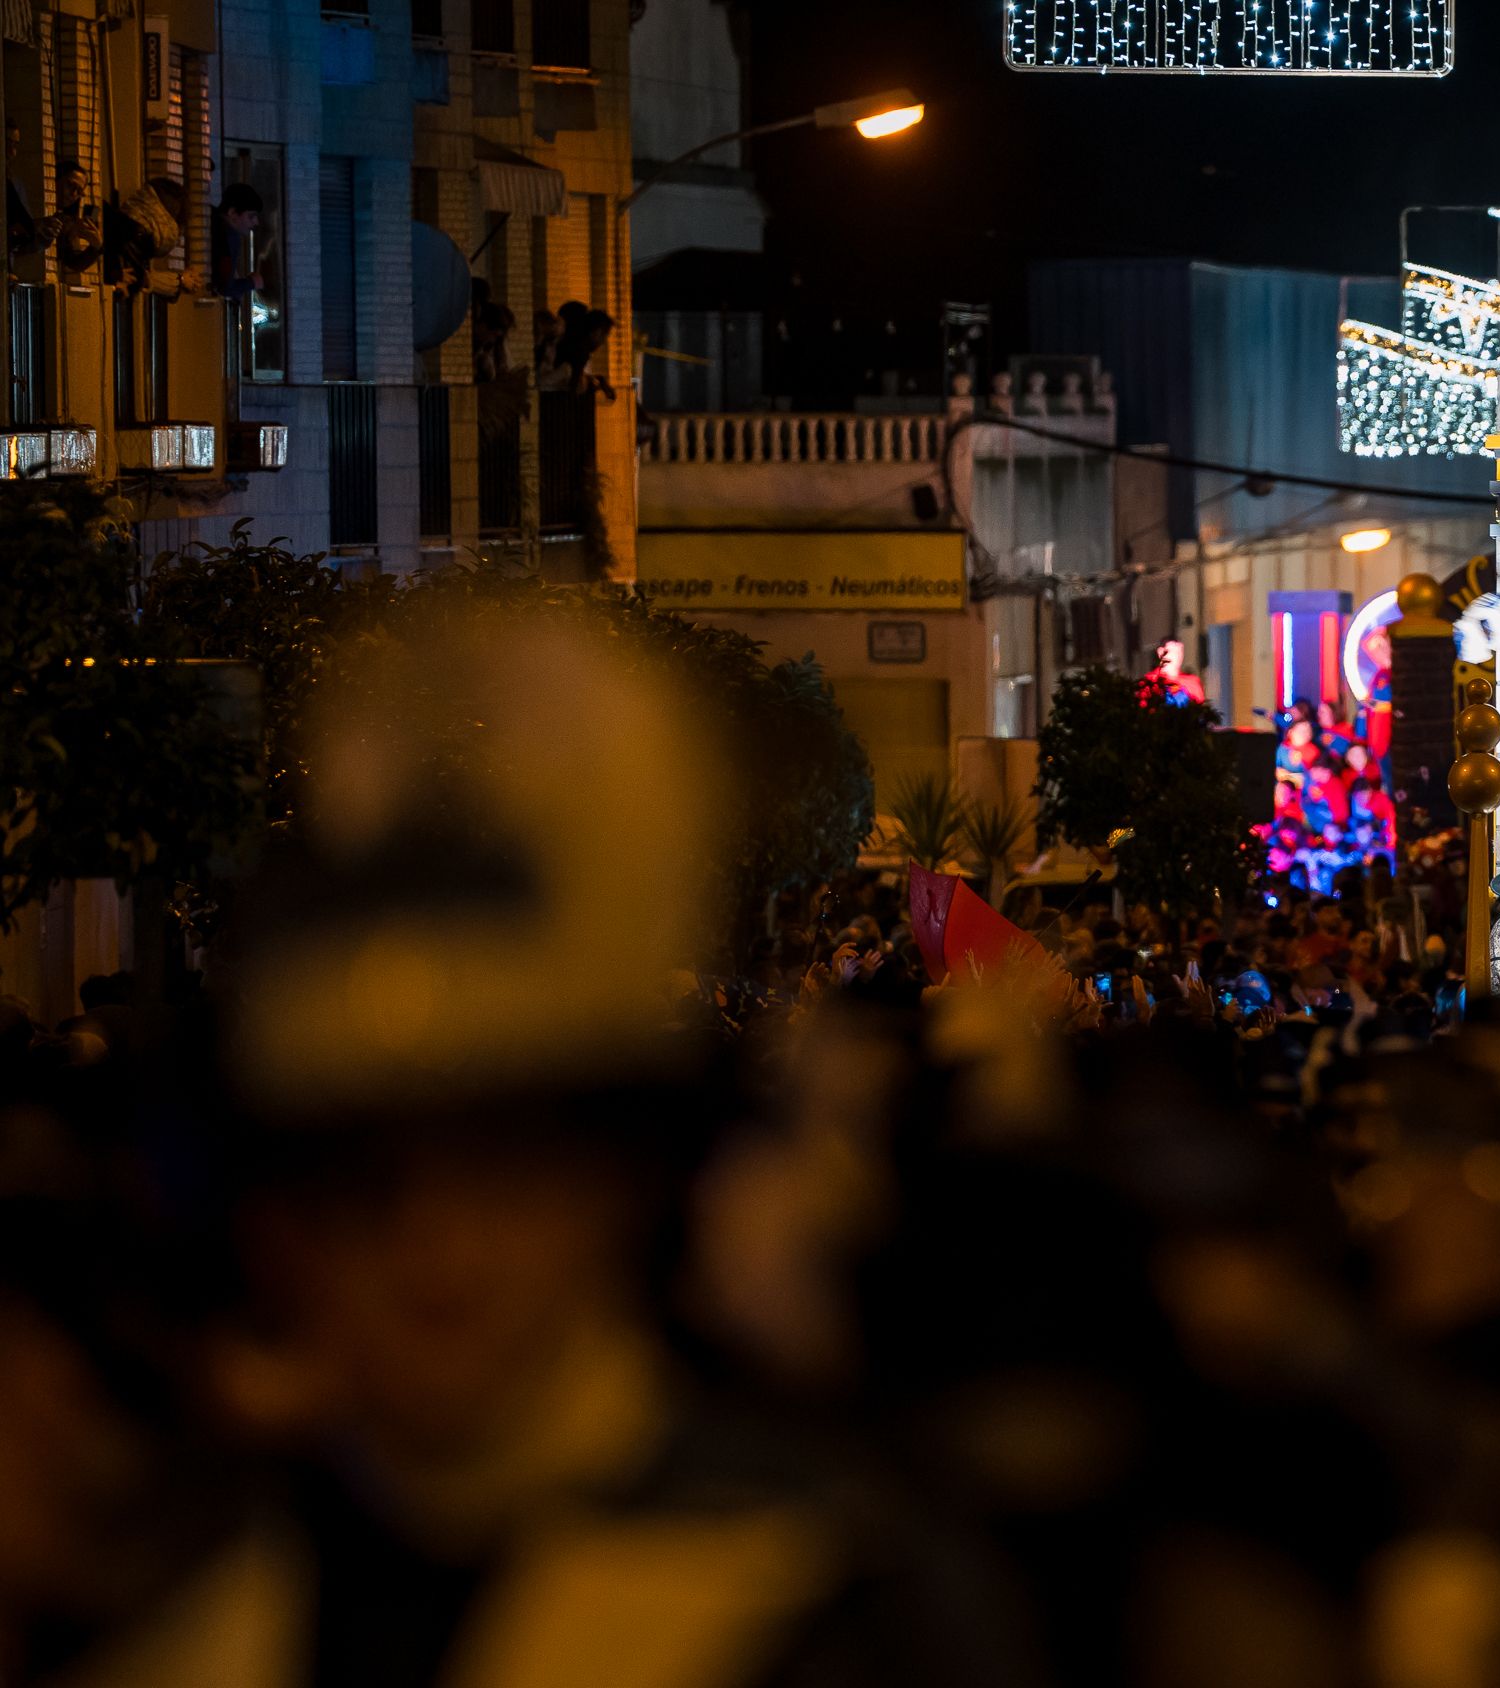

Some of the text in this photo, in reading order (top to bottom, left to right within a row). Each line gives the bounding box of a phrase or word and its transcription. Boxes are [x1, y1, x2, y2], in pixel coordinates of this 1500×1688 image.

[147, 36, 158, 98] DAEWOO
[735, 574, 809, 596] Frenos
[831, 574, 961, 596] Neumáticos
